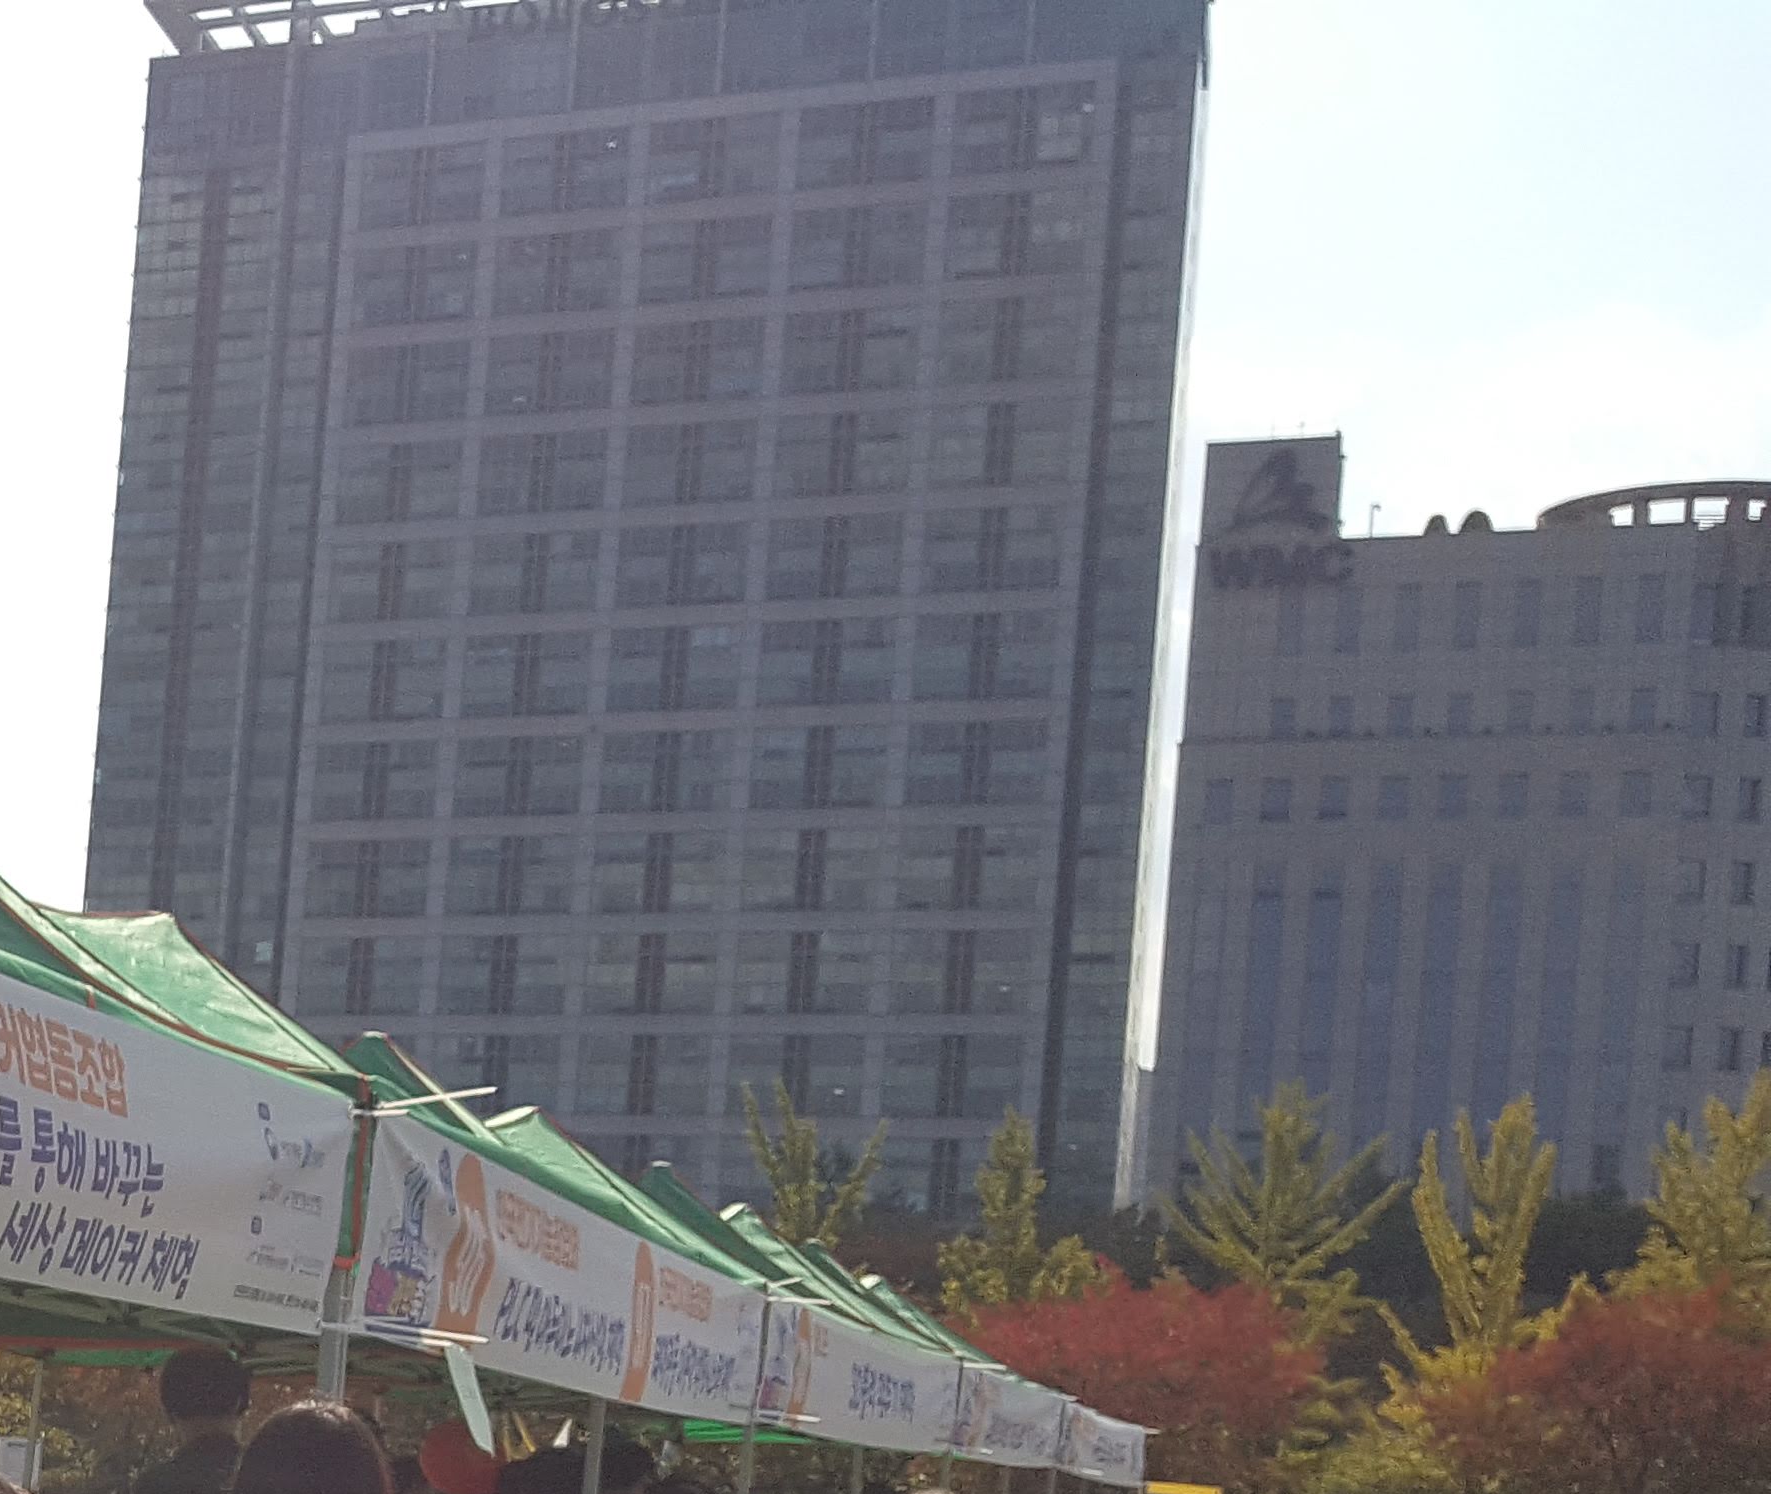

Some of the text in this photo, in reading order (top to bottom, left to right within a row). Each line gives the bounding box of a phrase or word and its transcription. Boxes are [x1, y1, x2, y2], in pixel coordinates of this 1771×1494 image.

[30, 1109, 88, 1194] 통해
[91, 1138, 164, 1217] 바꾸는
[61, 1216, 146, 1288] 메이커
[146, 1232, 199, 1300] 체험
